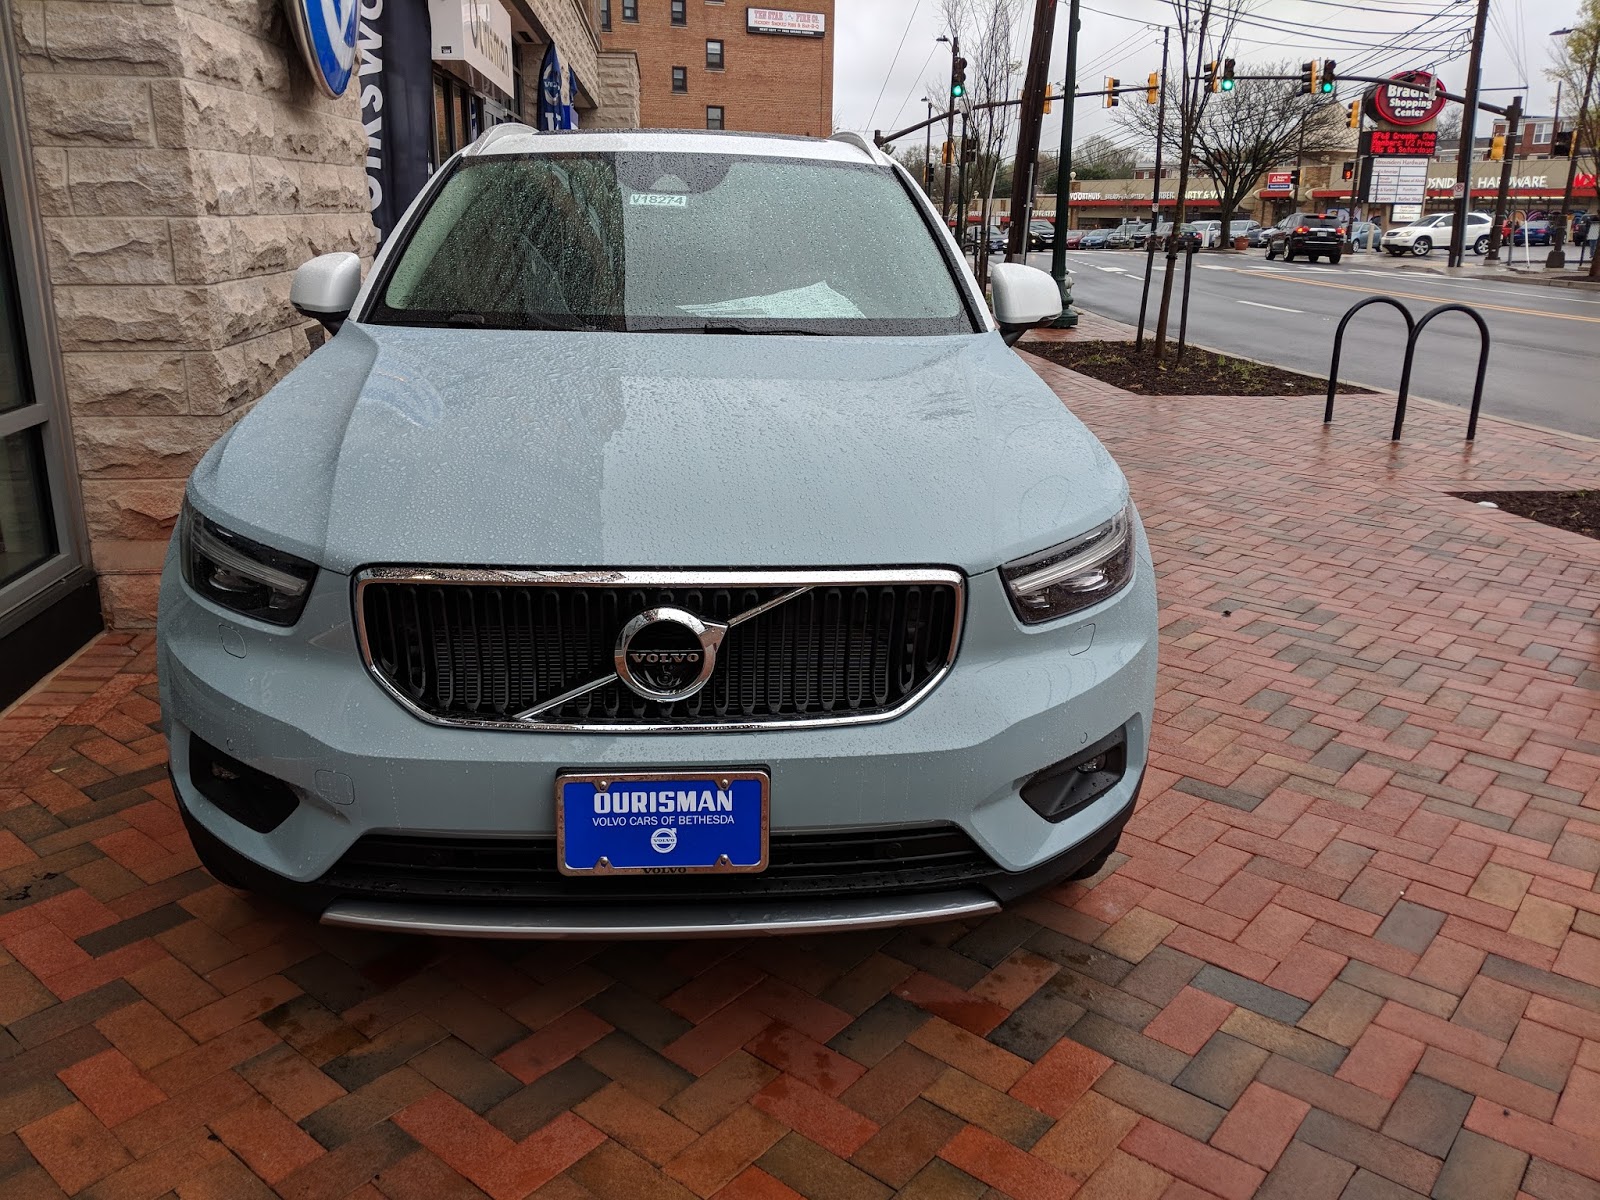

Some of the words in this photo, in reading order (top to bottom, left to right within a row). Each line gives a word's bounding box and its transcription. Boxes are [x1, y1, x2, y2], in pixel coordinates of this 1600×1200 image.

[1389, 98, 1433, 109] Shopping
[1394, 108, 1425, 117] Center
[1422, 132, 1437, 140] Club
[632, 195, 684, 205] V18274
[629, 653, 700, 664] VOLVO
[593, 790, 733, 814] OURISMAN
[592, 817, 627, 827] VOLVO
[629, 816, 658, 826] CARS
[661, 816, 675, 825] OF
[678, 815, 735, 825] BETHESDA
